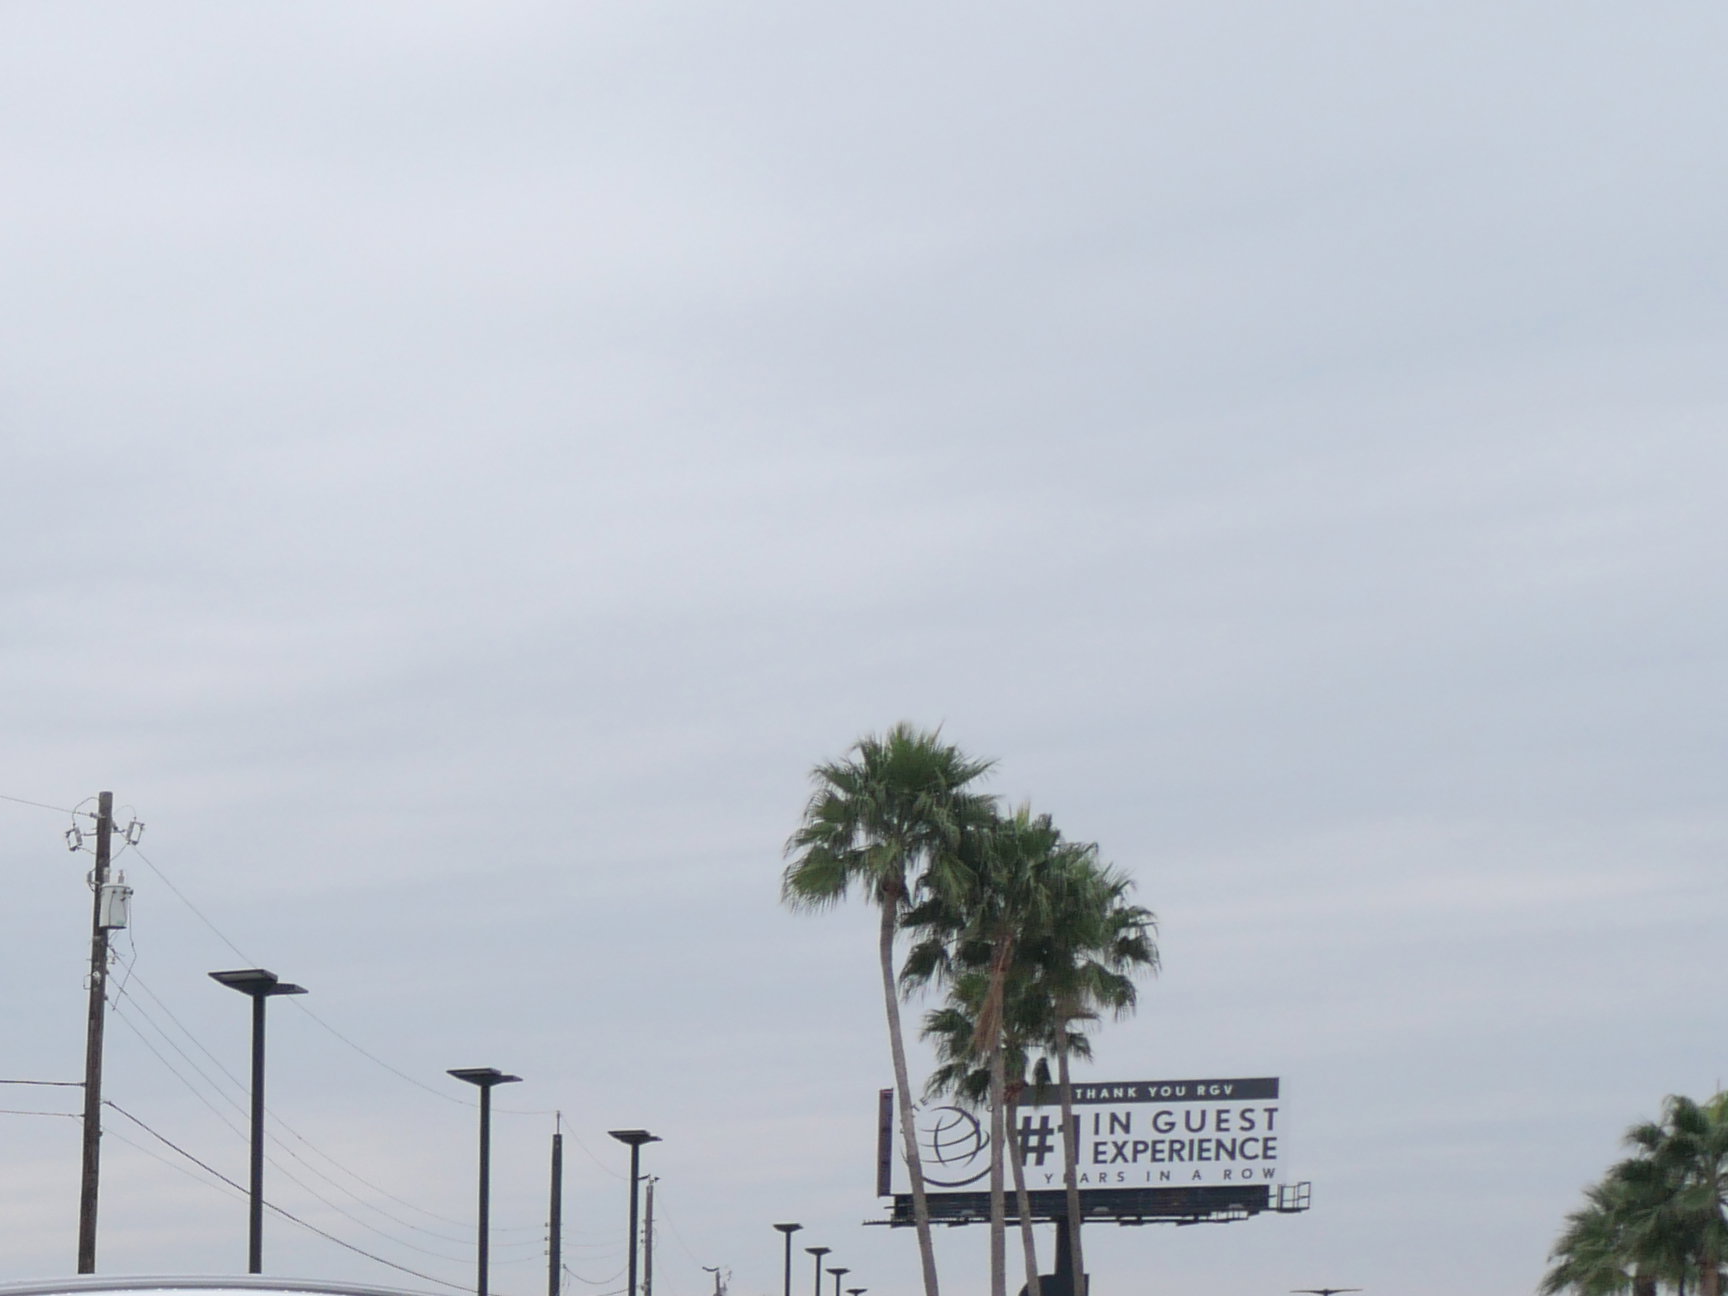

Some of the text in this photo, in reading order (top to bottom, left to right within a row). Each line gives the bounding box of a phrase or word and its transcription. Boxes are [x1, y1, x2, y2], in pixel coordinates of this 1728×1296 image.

[1075, 1084, 1233, 1099] THANK YOU RGV
[1017, 1107, 1279, 1166] #1 IN GUEST
[1093, 1137, 1277, 1165] EXPERIENCE
[1146, 1170, 1170, 1182] IN
[1192, 1169, 1202, 1181] A
[1223, 1167, 1275, 1180] ROW
